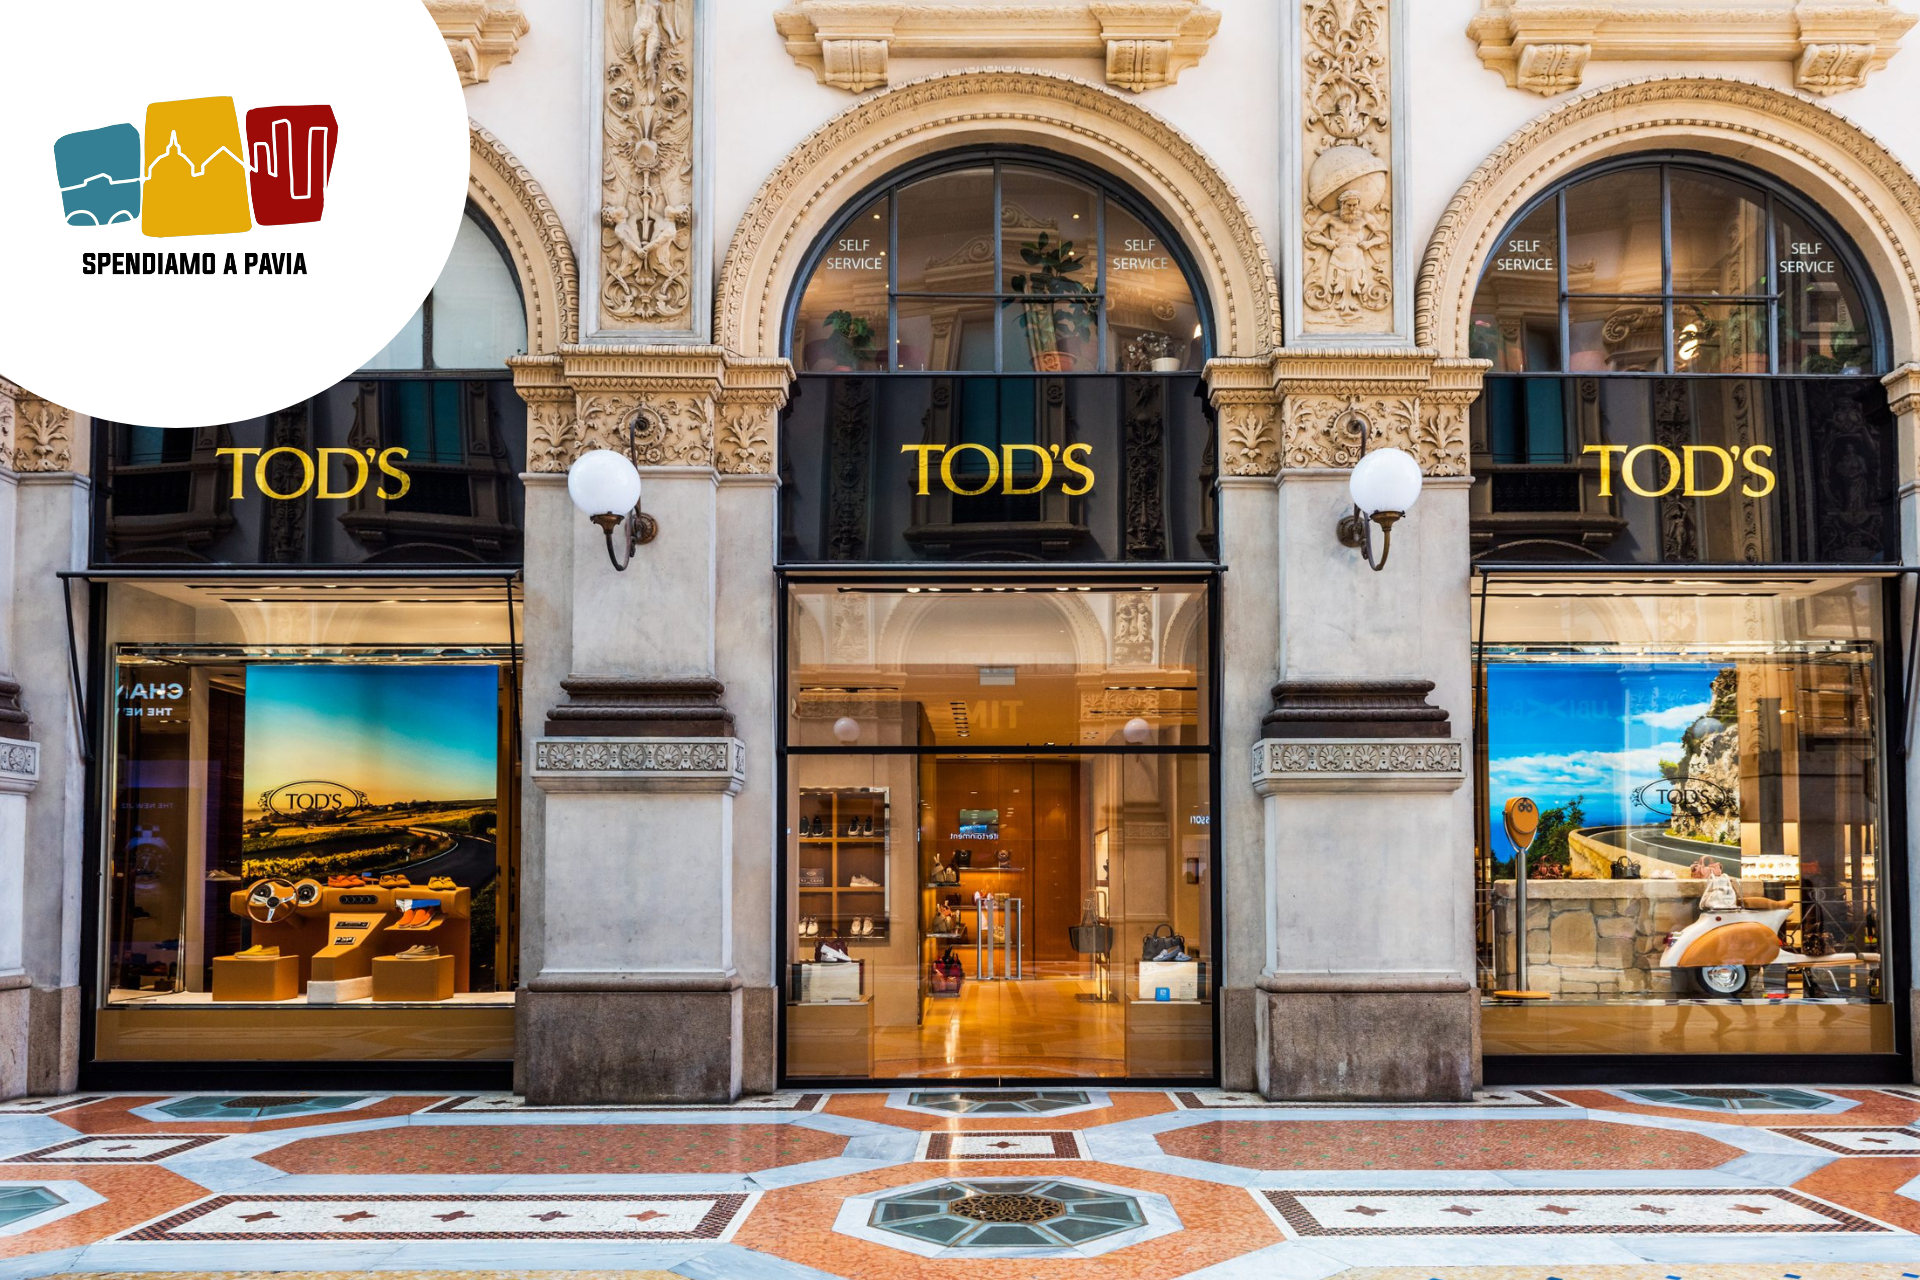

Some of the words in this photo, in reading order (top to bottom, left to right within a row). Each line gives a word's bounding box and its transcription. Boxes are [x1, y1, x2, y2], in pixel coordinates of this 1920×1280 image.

[839, 239, 870, 252] SELF
[1124, 239, 1156, 252] SELF
[1509, 240, 1541, 252] SELF
[1791, 242, 1823, 255] SELF
[826, 257, 883, 270] SERVICE
[1113, 257, 1169, 270] SERVICE
[1497, 258, 1554, 271] SERVICE
[1779, 260, 1836, 273] SERVICE
[215, 446, 411, 500] TOD'S
[901, 442, 1096, 496] TOD'S
[1582, 444, 1776, 498] TOD'S
[285, 793, 342, 810] TOD'S
[1656, 788, 1710, 805] TOD'S
